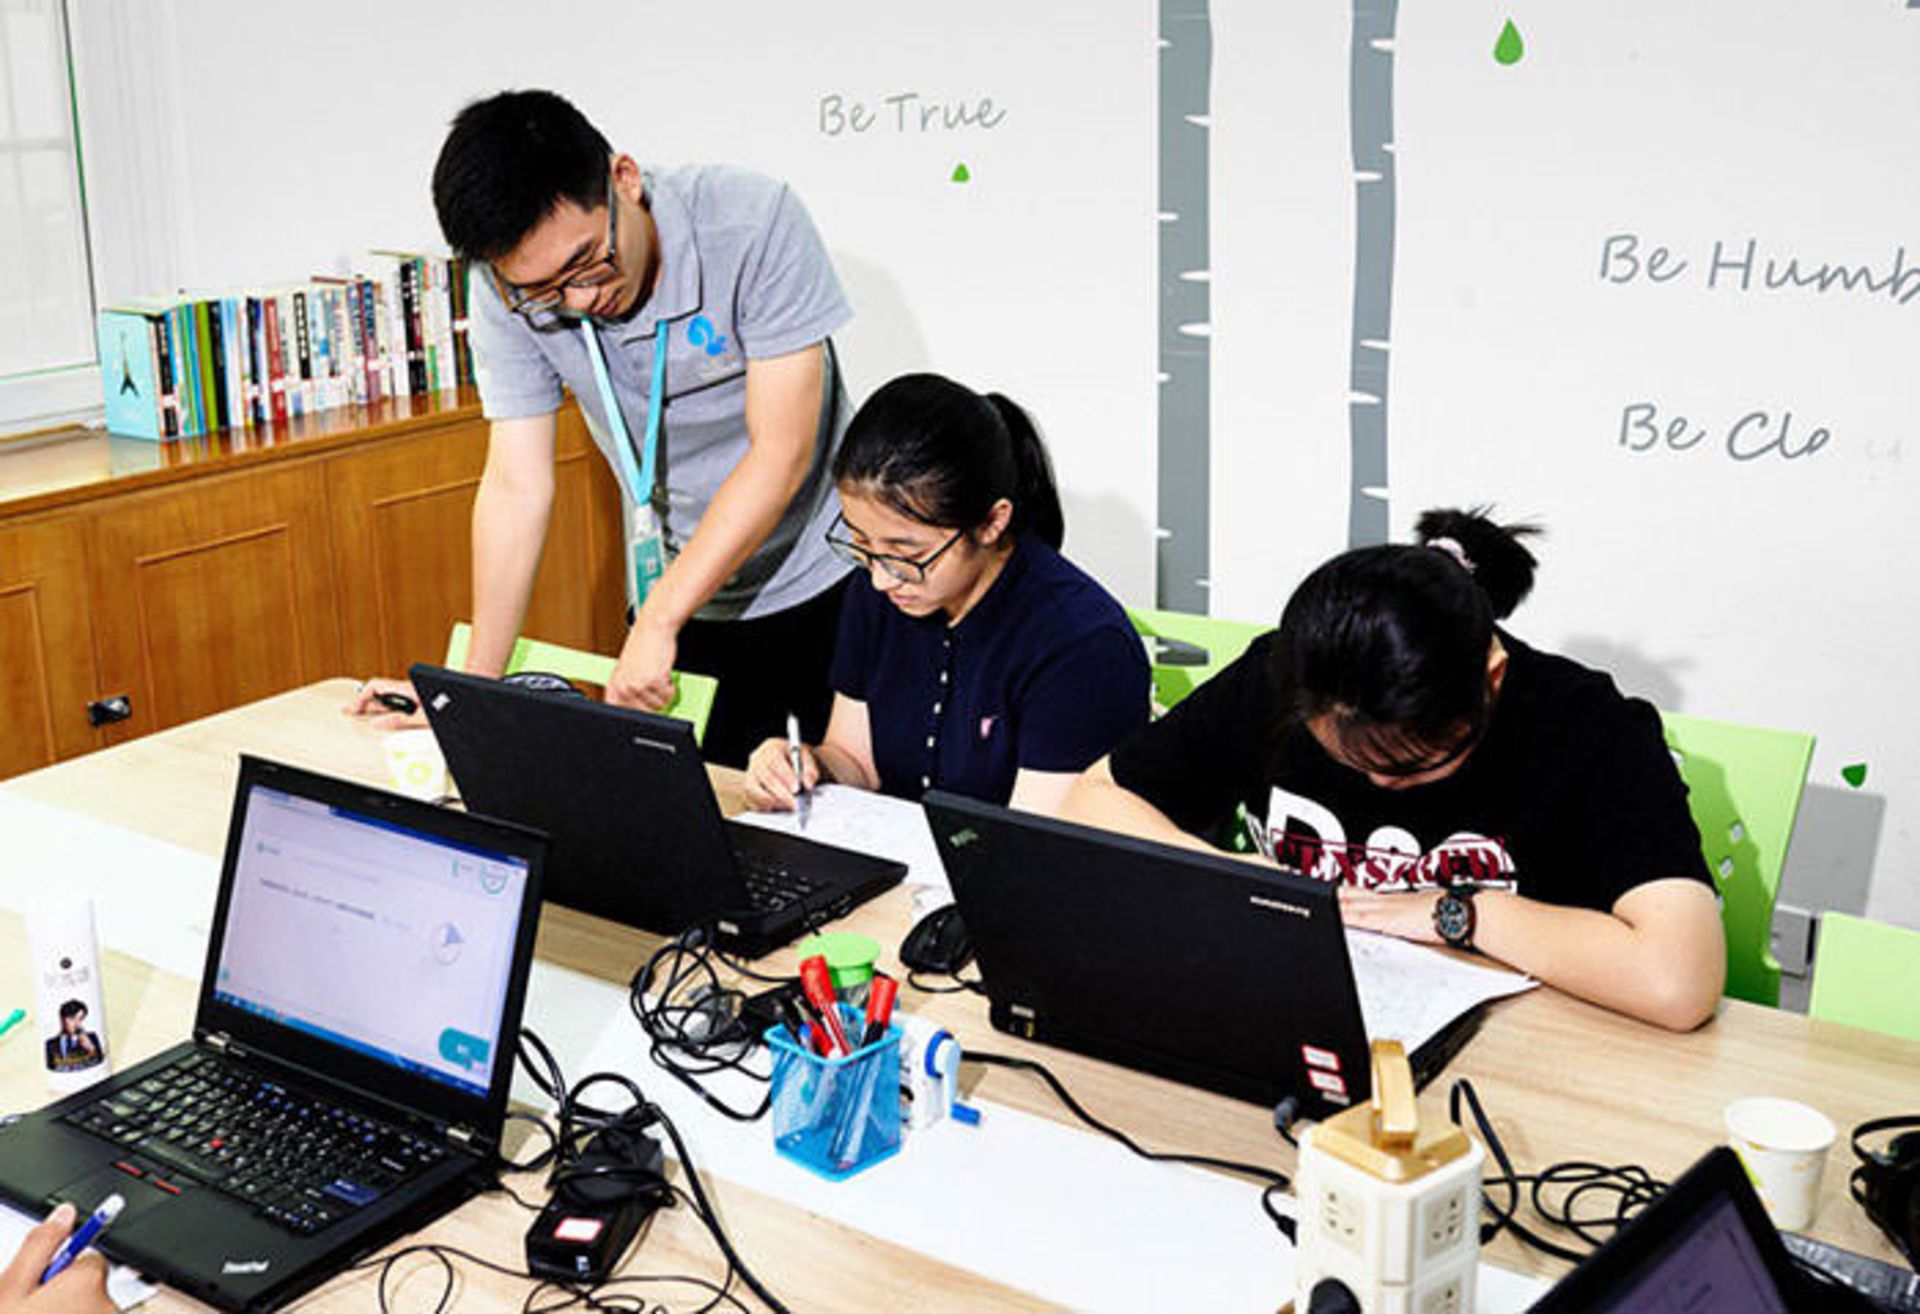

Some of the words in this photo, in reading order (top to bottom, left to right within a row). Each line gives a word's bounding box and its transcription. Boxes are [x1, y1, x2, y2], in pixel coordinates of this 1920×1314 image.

[819, 94, 876, 136] Be
[885, 92, 1007, 132] True
[1600, 233, 1688, 284] Be
[1619, 402, 1706, 451] Be
